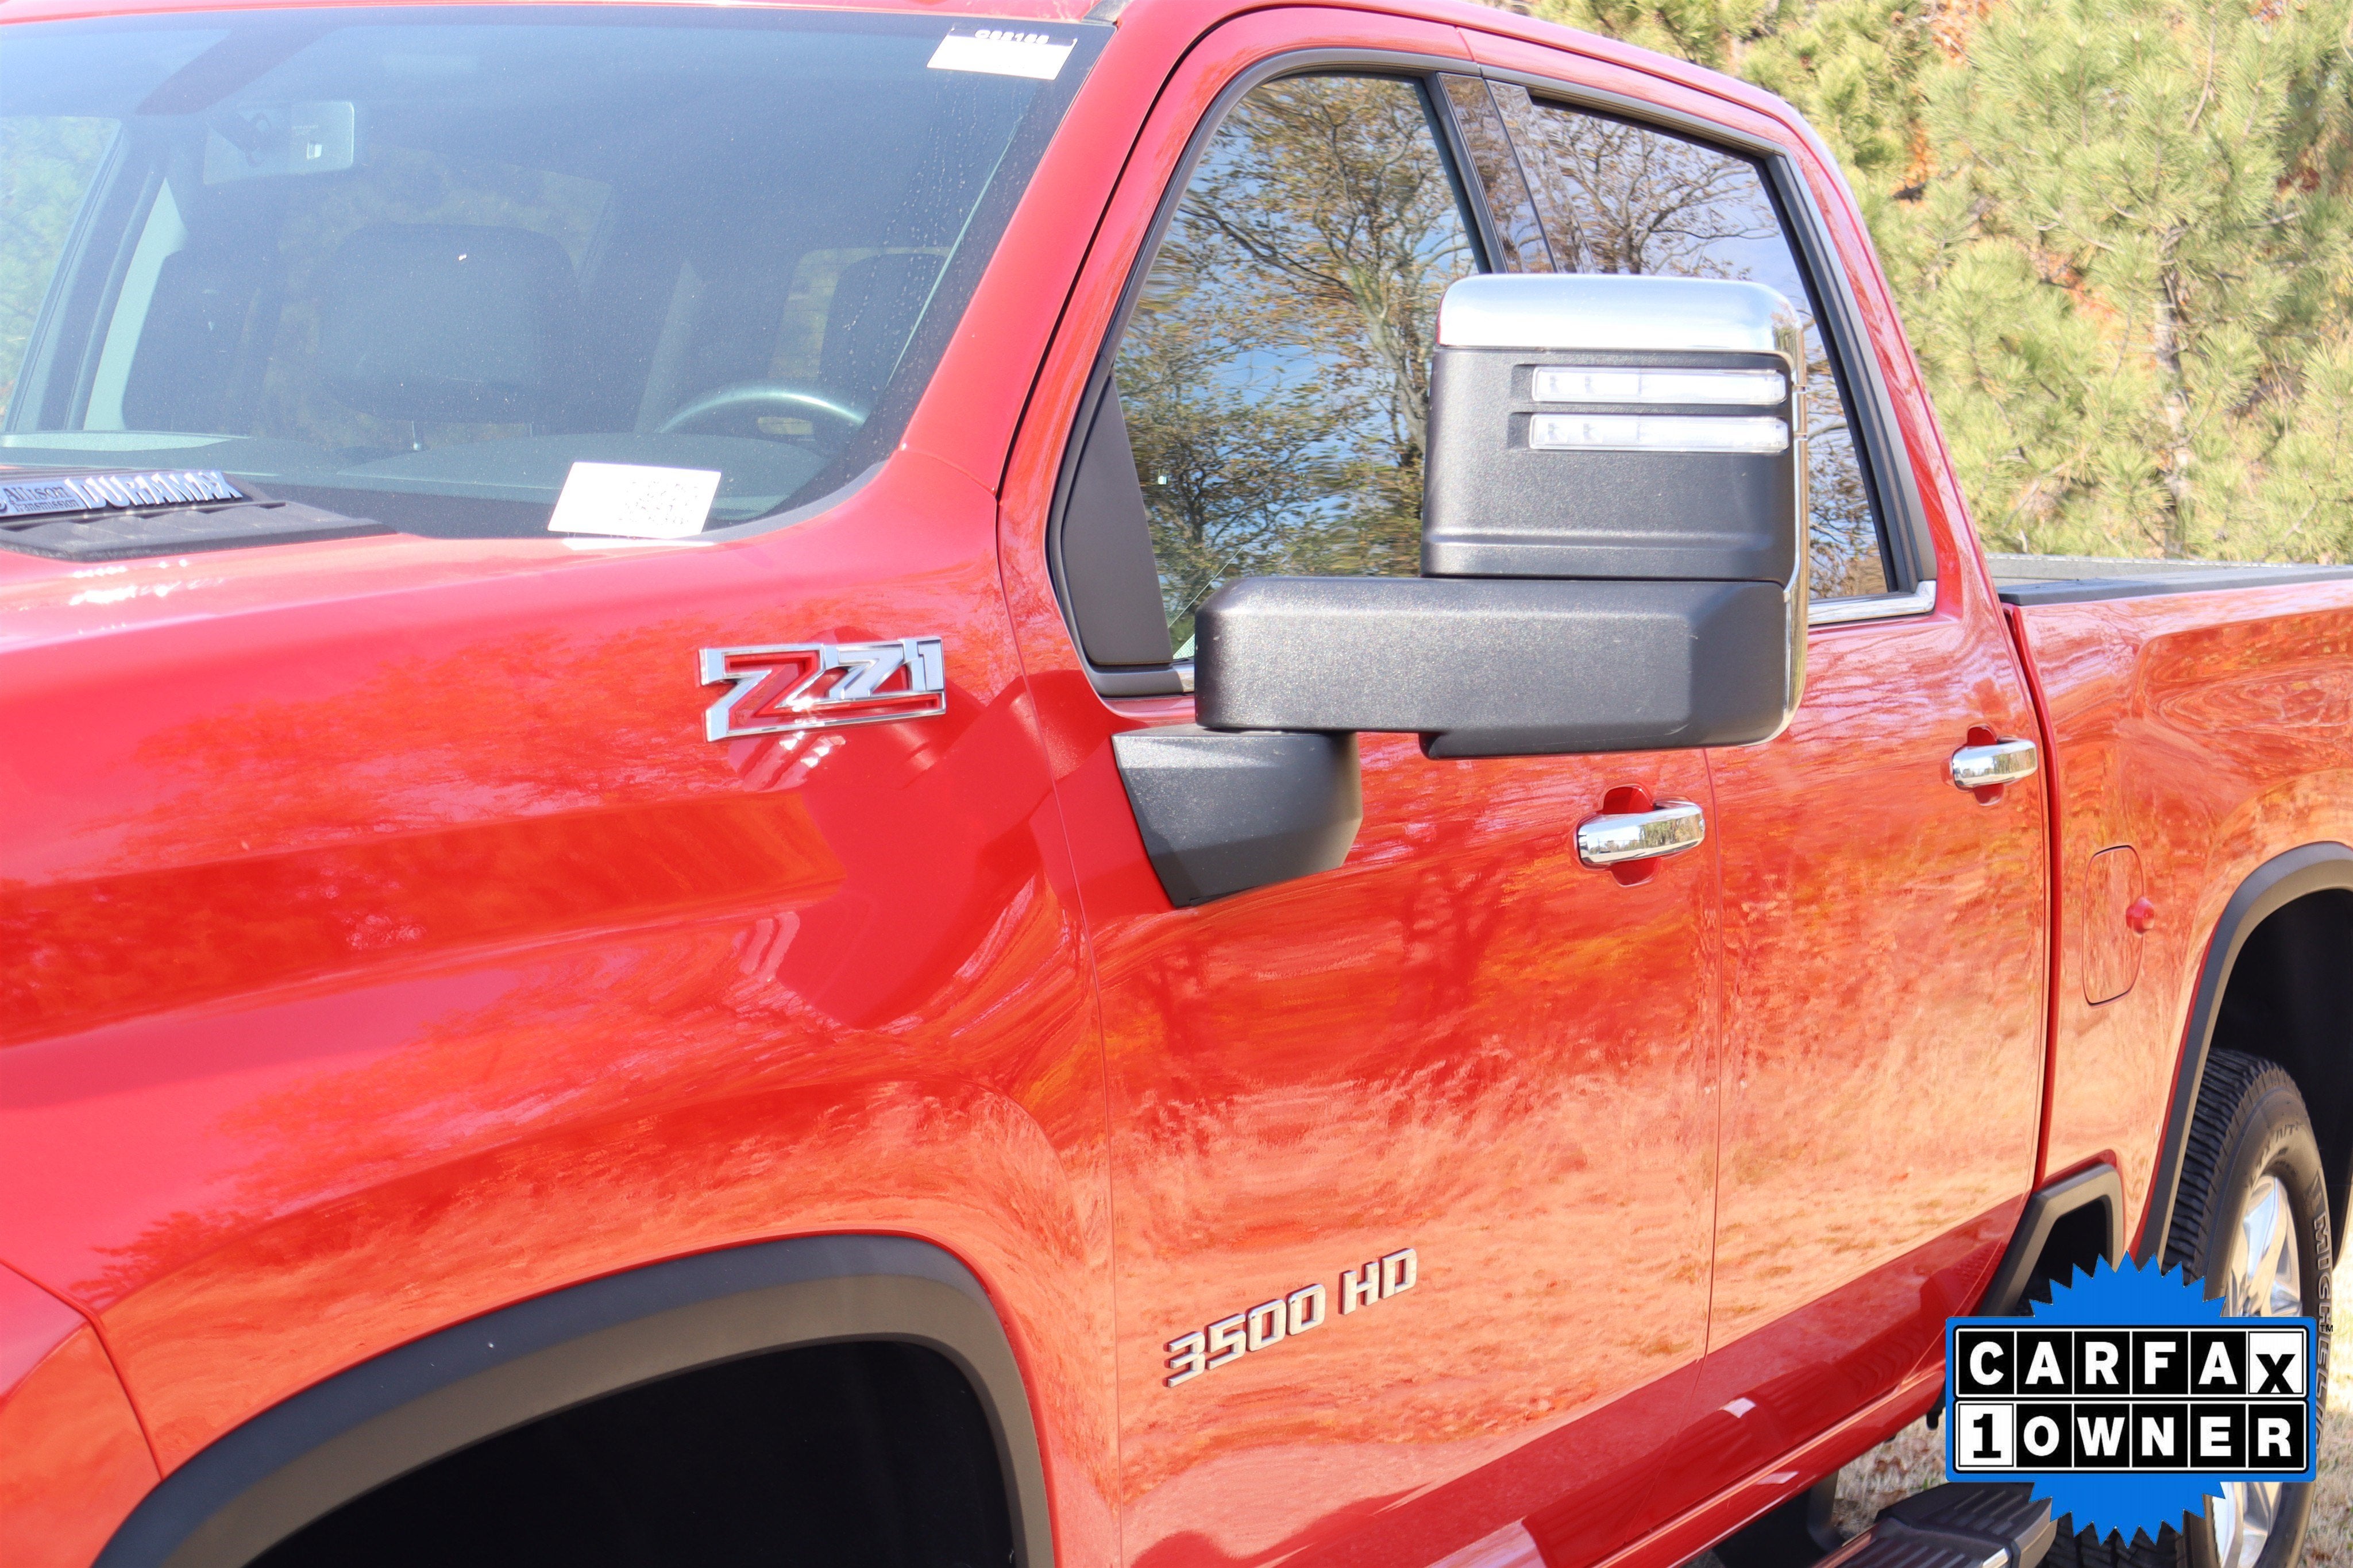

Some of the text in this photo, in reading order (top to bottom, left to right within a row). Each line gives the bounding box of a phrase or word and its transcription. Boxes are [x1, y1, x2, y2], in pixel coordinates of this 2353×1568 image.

[3, 486, 74, 503] Allison
[12, 499, 80, 512] Transmission
[64, 470, 243, 509] DURAMAX
[699, 636, 946, 742] Z71
[1164, 1248, 1418, 1388] 3500 HD
